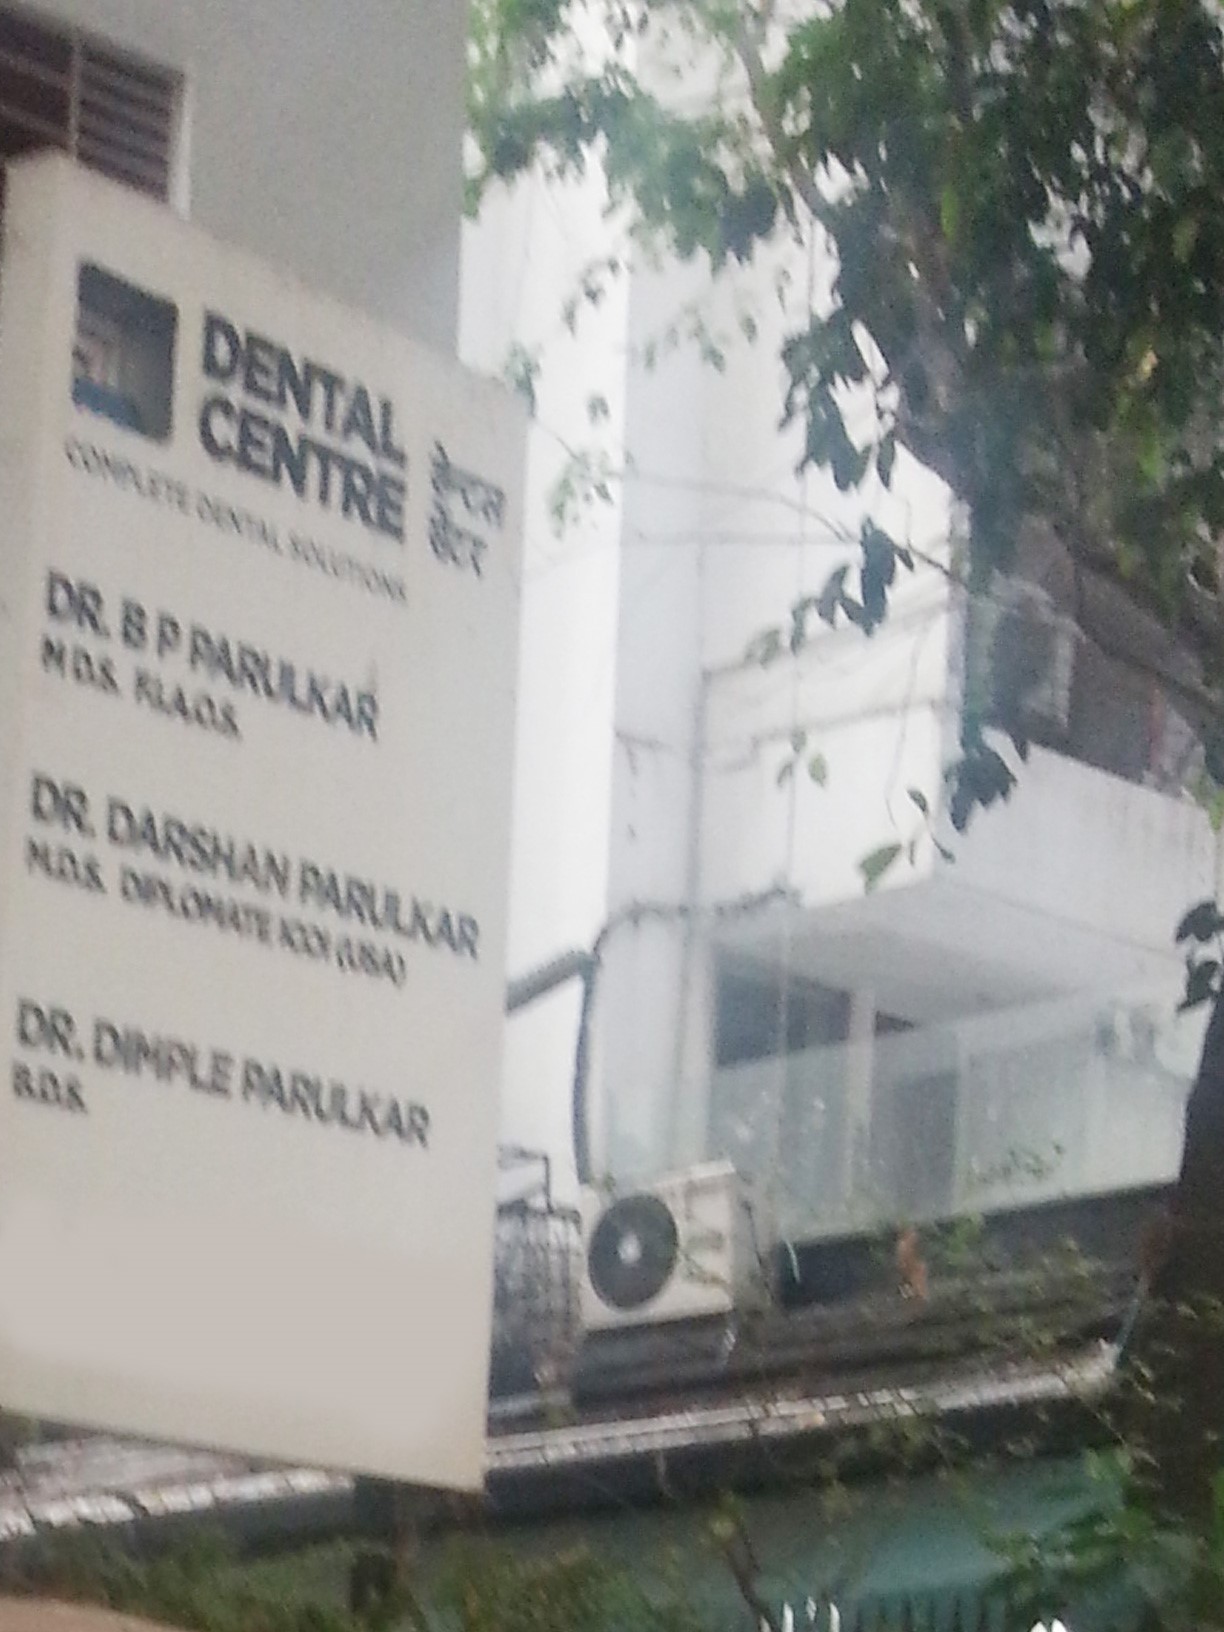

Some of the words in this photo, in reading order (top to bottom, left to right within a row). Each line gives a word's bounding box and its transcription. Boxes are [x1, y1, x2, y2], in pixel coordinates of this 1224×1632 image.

[202, 308, 406, 464] DENTAL
[196, 491, 283, 555] DENTAL
[199, 394, 406, 543] CENTRE
[189, 623, 378, 742] PARULKAR
[106, 795, 290, 899] DARSHAN
[298, 858, 480, 959] PARULKAR
[92, 1016, 234, 1100] DIMPLE
[242, 1056, 430, 1150] PARULKAR
